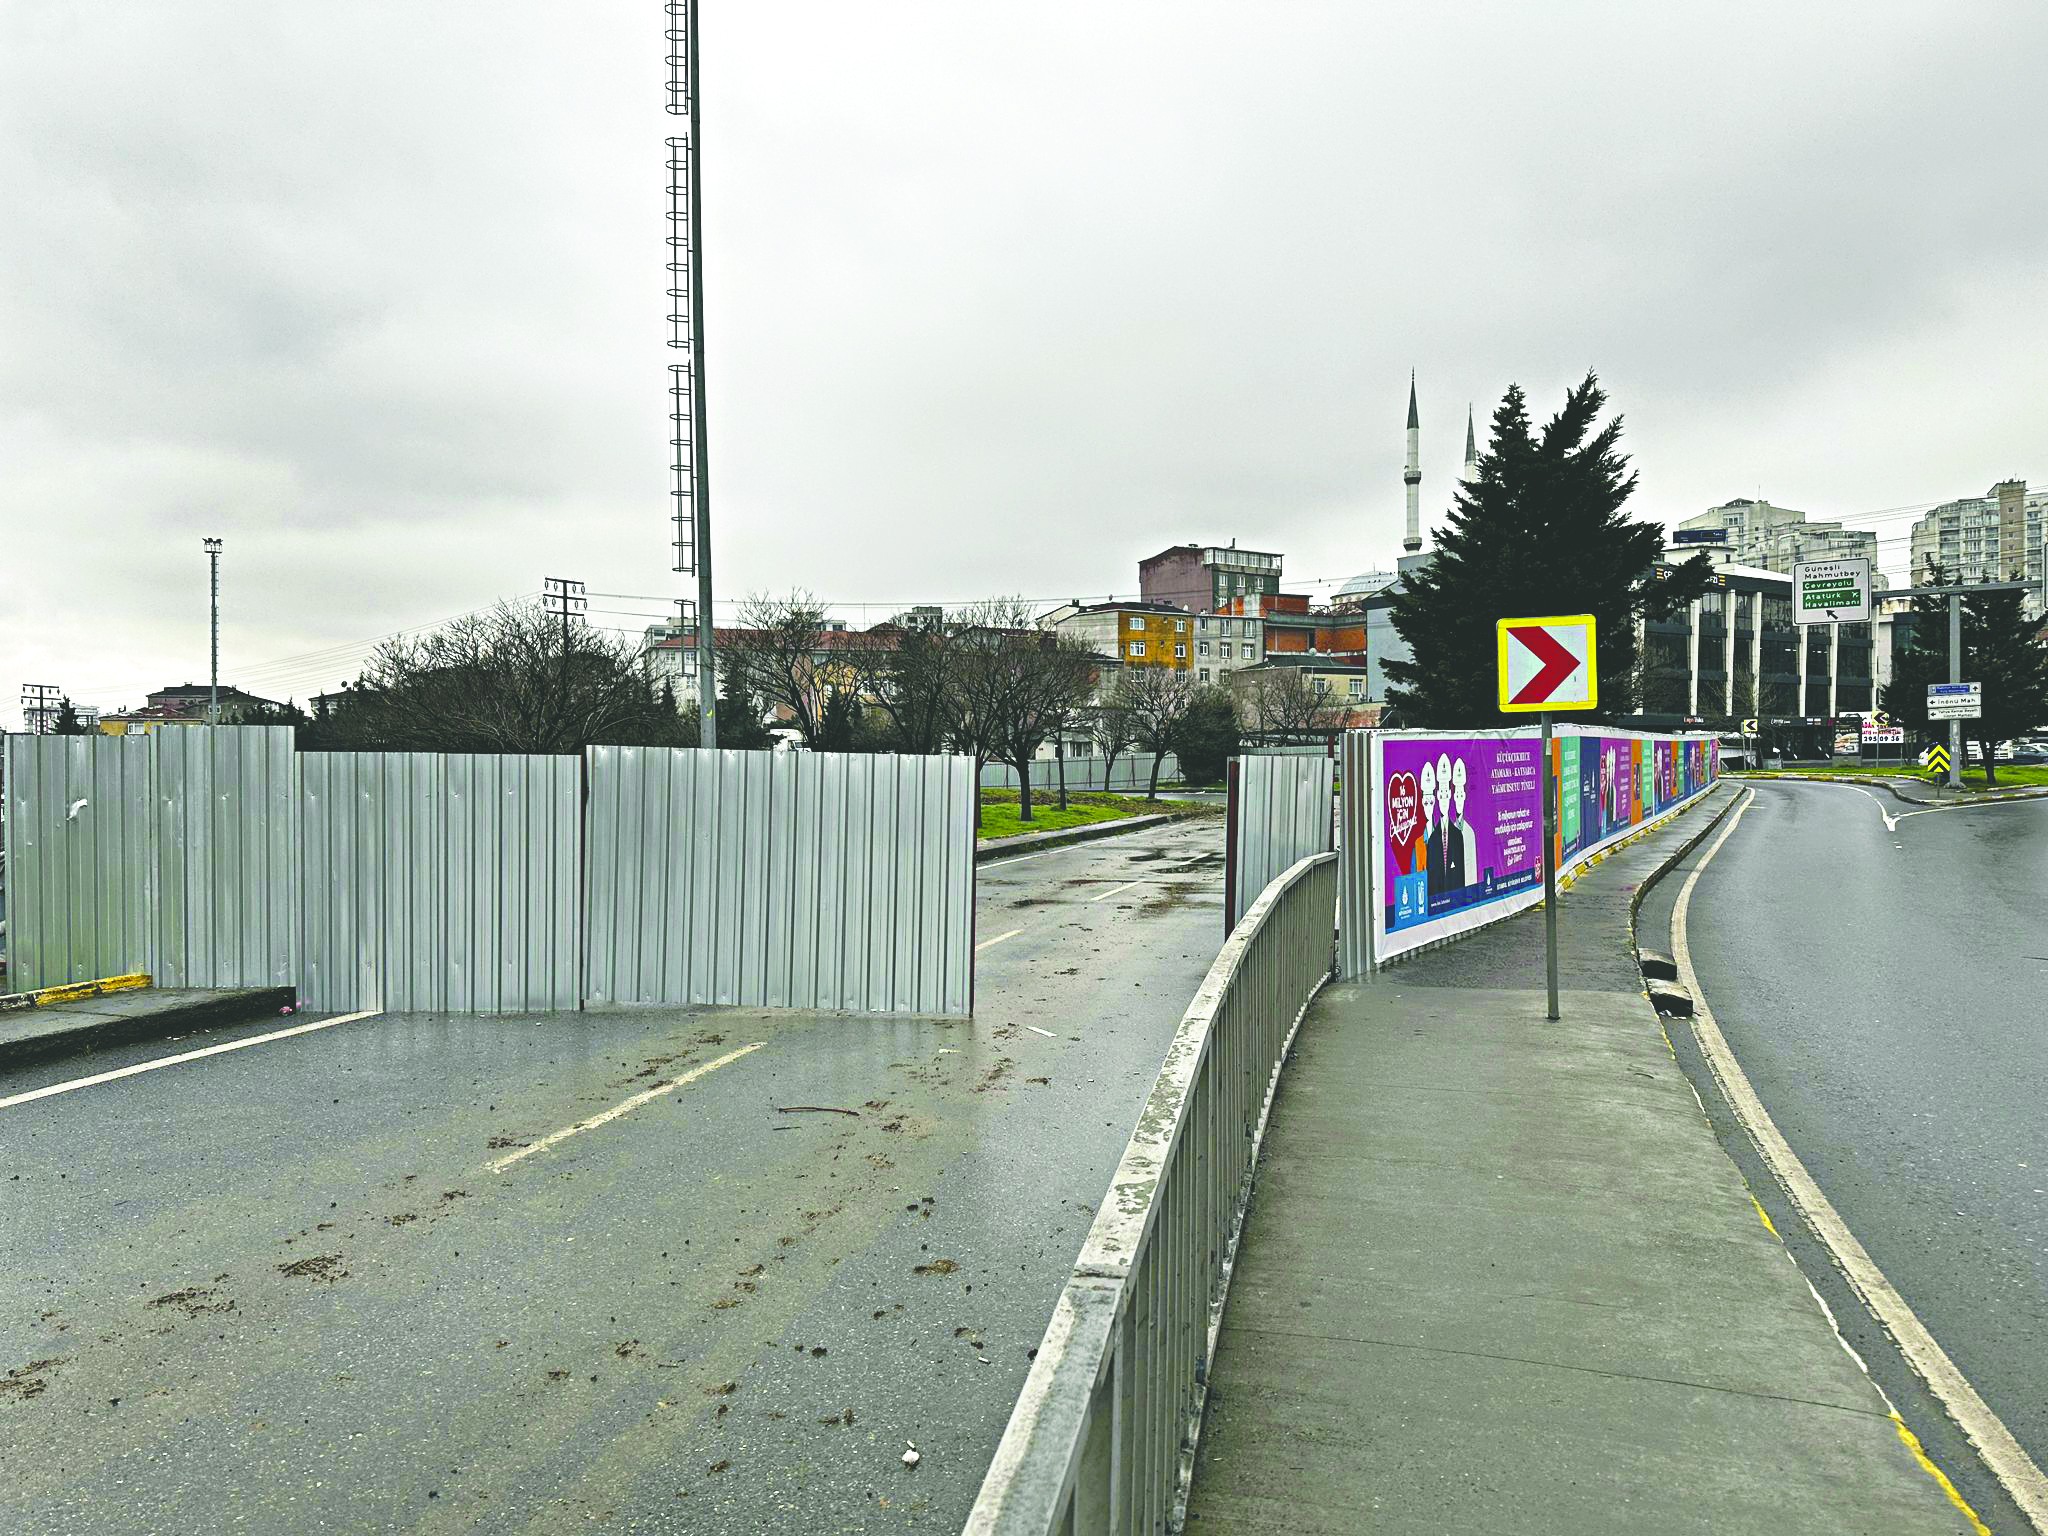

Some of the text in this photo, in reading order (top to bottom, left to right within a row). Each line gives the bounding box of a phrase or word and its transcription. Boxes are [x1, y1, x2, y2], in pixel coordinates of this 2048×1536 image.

[1804, 564, 1840, 573] Güneşli
[1804, 571, 1861, 580] Mahmutbey
[1804, 580, 1852, 590] Çevreyolu
[1805, 592, 1841, 601] Atatürk
[1399, 785, 1406, 796] 16
[1392, 796, 1414, 809] MİLYON
